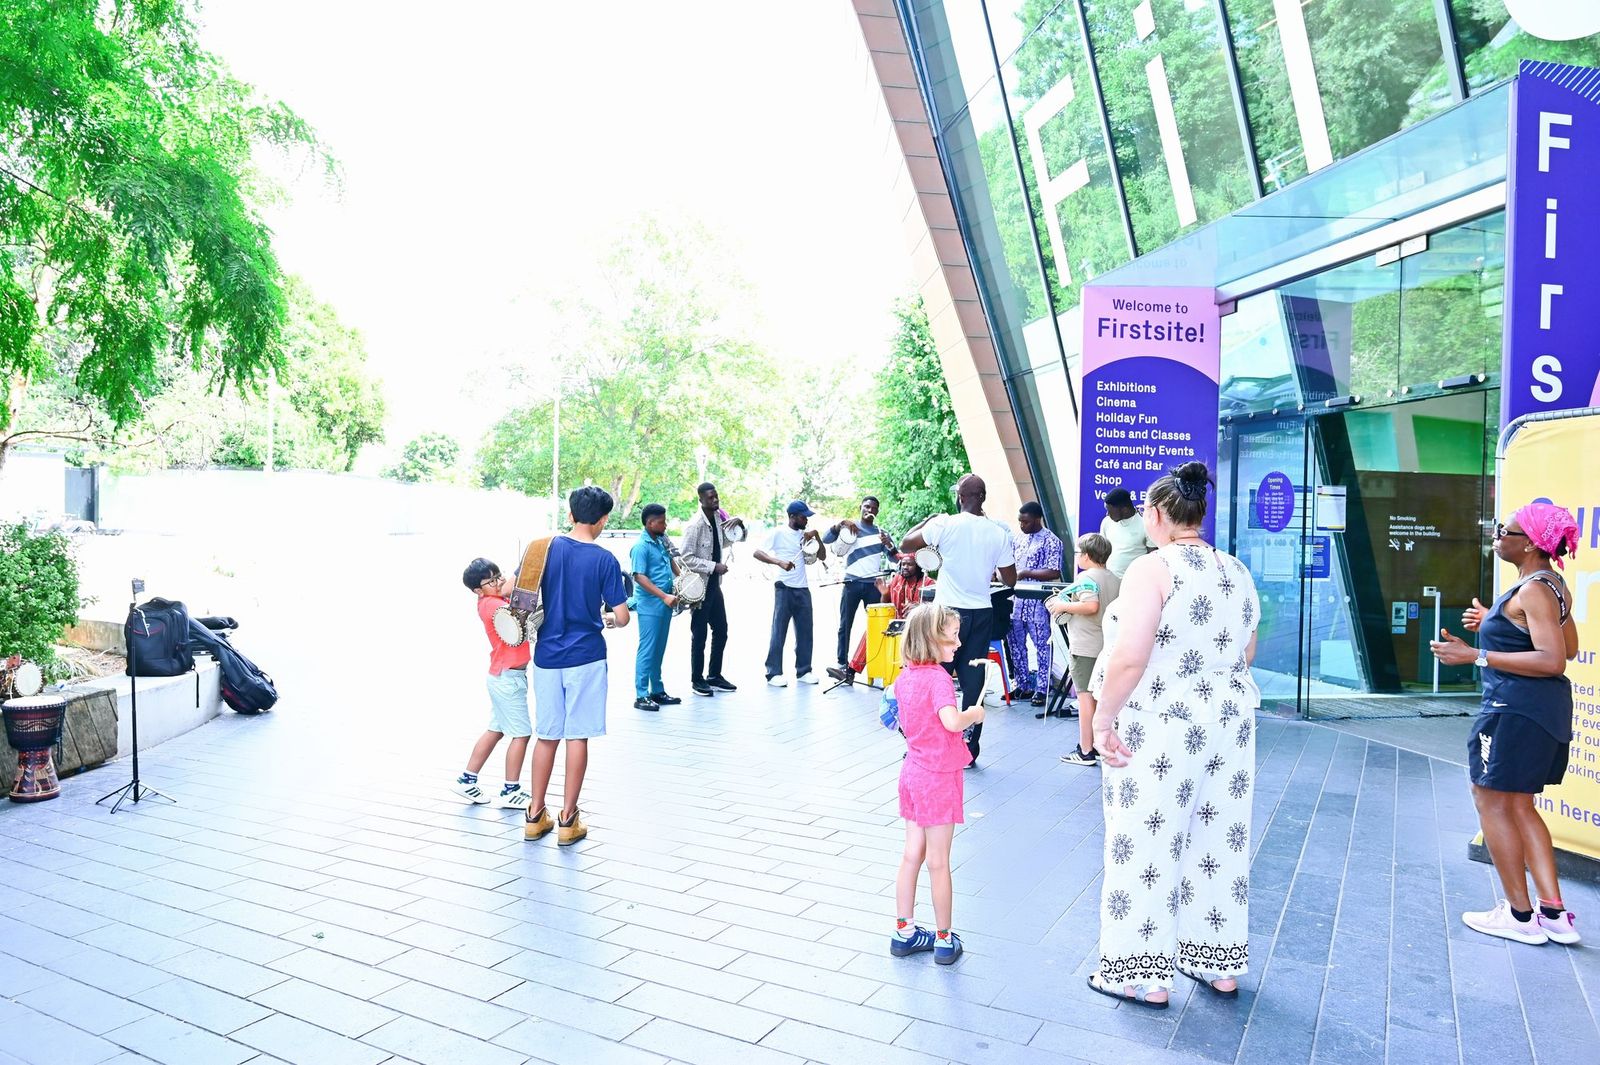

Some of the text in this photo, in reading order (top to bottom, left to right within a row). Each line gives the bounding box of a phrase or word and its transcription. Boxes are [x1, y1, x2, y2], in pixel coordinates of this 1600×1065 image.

[1112, 298, 1188, 314] Welcome to
[1098, 317, 1205, 343] Firstsite!
[1096, 380, 1157, 393] Exhibitions
[1096, 396, 1137, 408] Cinema
[1096, 412, 1158, 425] Holiday Fun
[1095, 428, 1191, 441] Clubs and Classes
[1095, 443, 1195, 457] Community Events
[1095, 458, 1163, 471] Café and Bar
[1094, 474, 1122, 486] Shop
[1568, 650, 1597, 665] ur
[1479, 732, 1492, 763] NIKE
[1560, 798, 1600, 827] here
